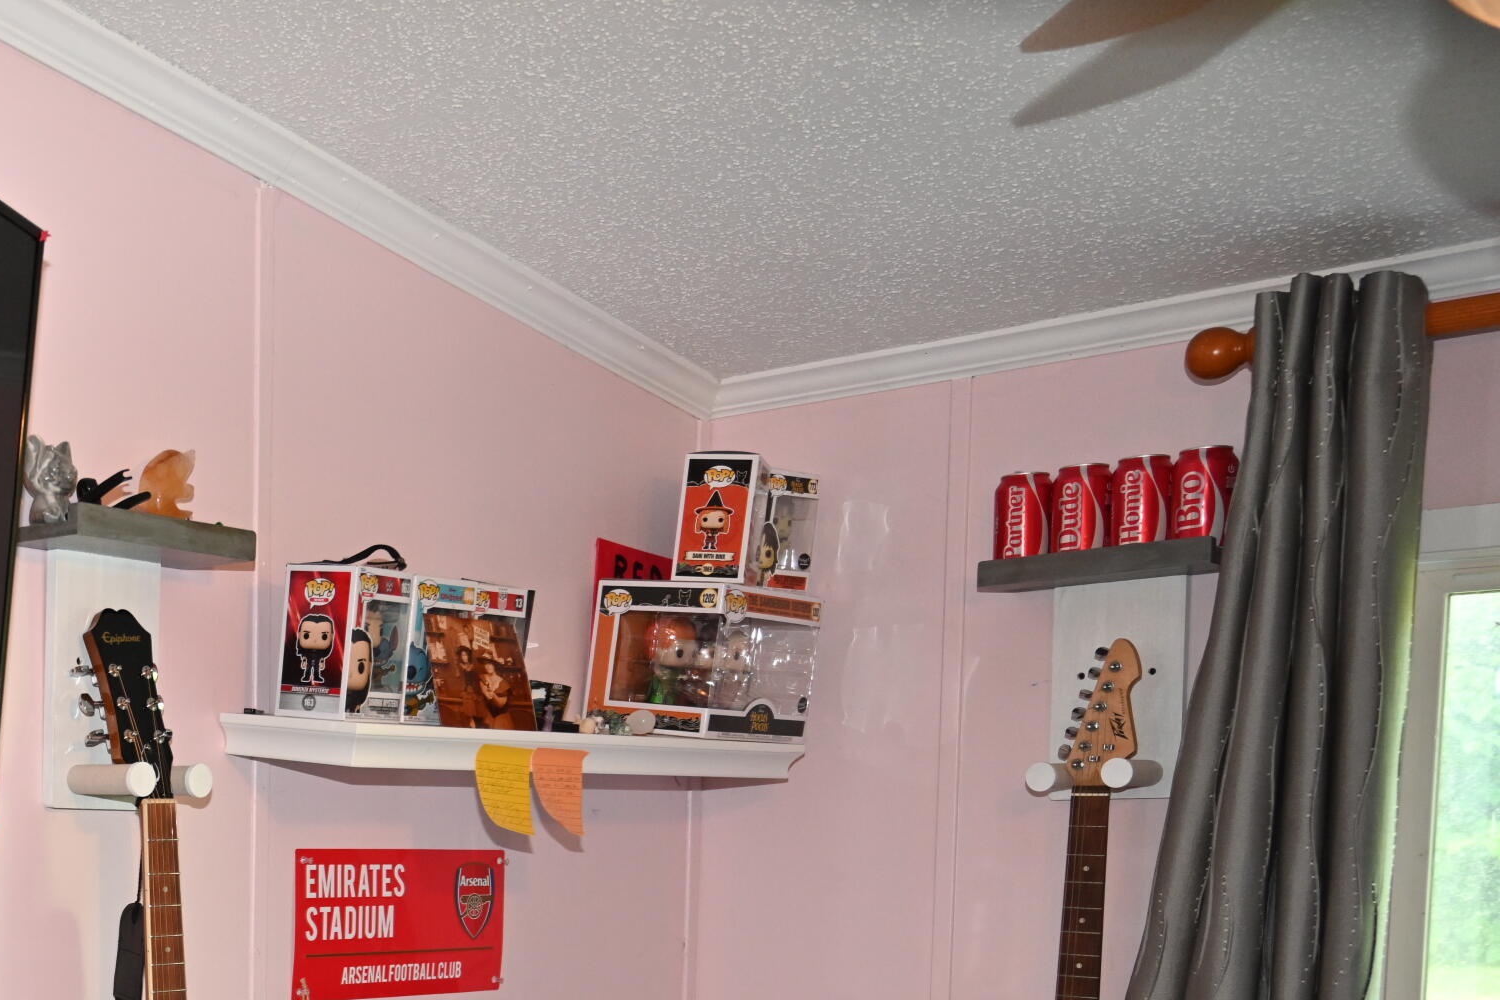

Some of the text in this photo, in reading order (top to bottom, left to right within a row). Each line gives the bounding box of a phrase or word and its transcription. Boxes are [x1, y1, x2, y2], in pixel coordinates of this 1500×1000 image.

[706, 468, 736, 484] POP!
[1119, 469, 1144, 545] Homie
[1176, 470, 1206, 533] Bro
[1002, 484, 1026, 559] Partner
[1059, 481, 1083, 551] Dude
[305, 579, 336, 597] POP!
[418, 583, 441, 601] POP!
[604, 591, 633, 609] POP!
[101, 631, 141, 645] Epiphone
[305, 863, 406, 899] EMIRATES
[460, 874, 490, 888] Arsenal
[305, 904, 395, 941] STADIUM
[341, 961, 462, 985] ARSENAL FOOTBALL CLUB
